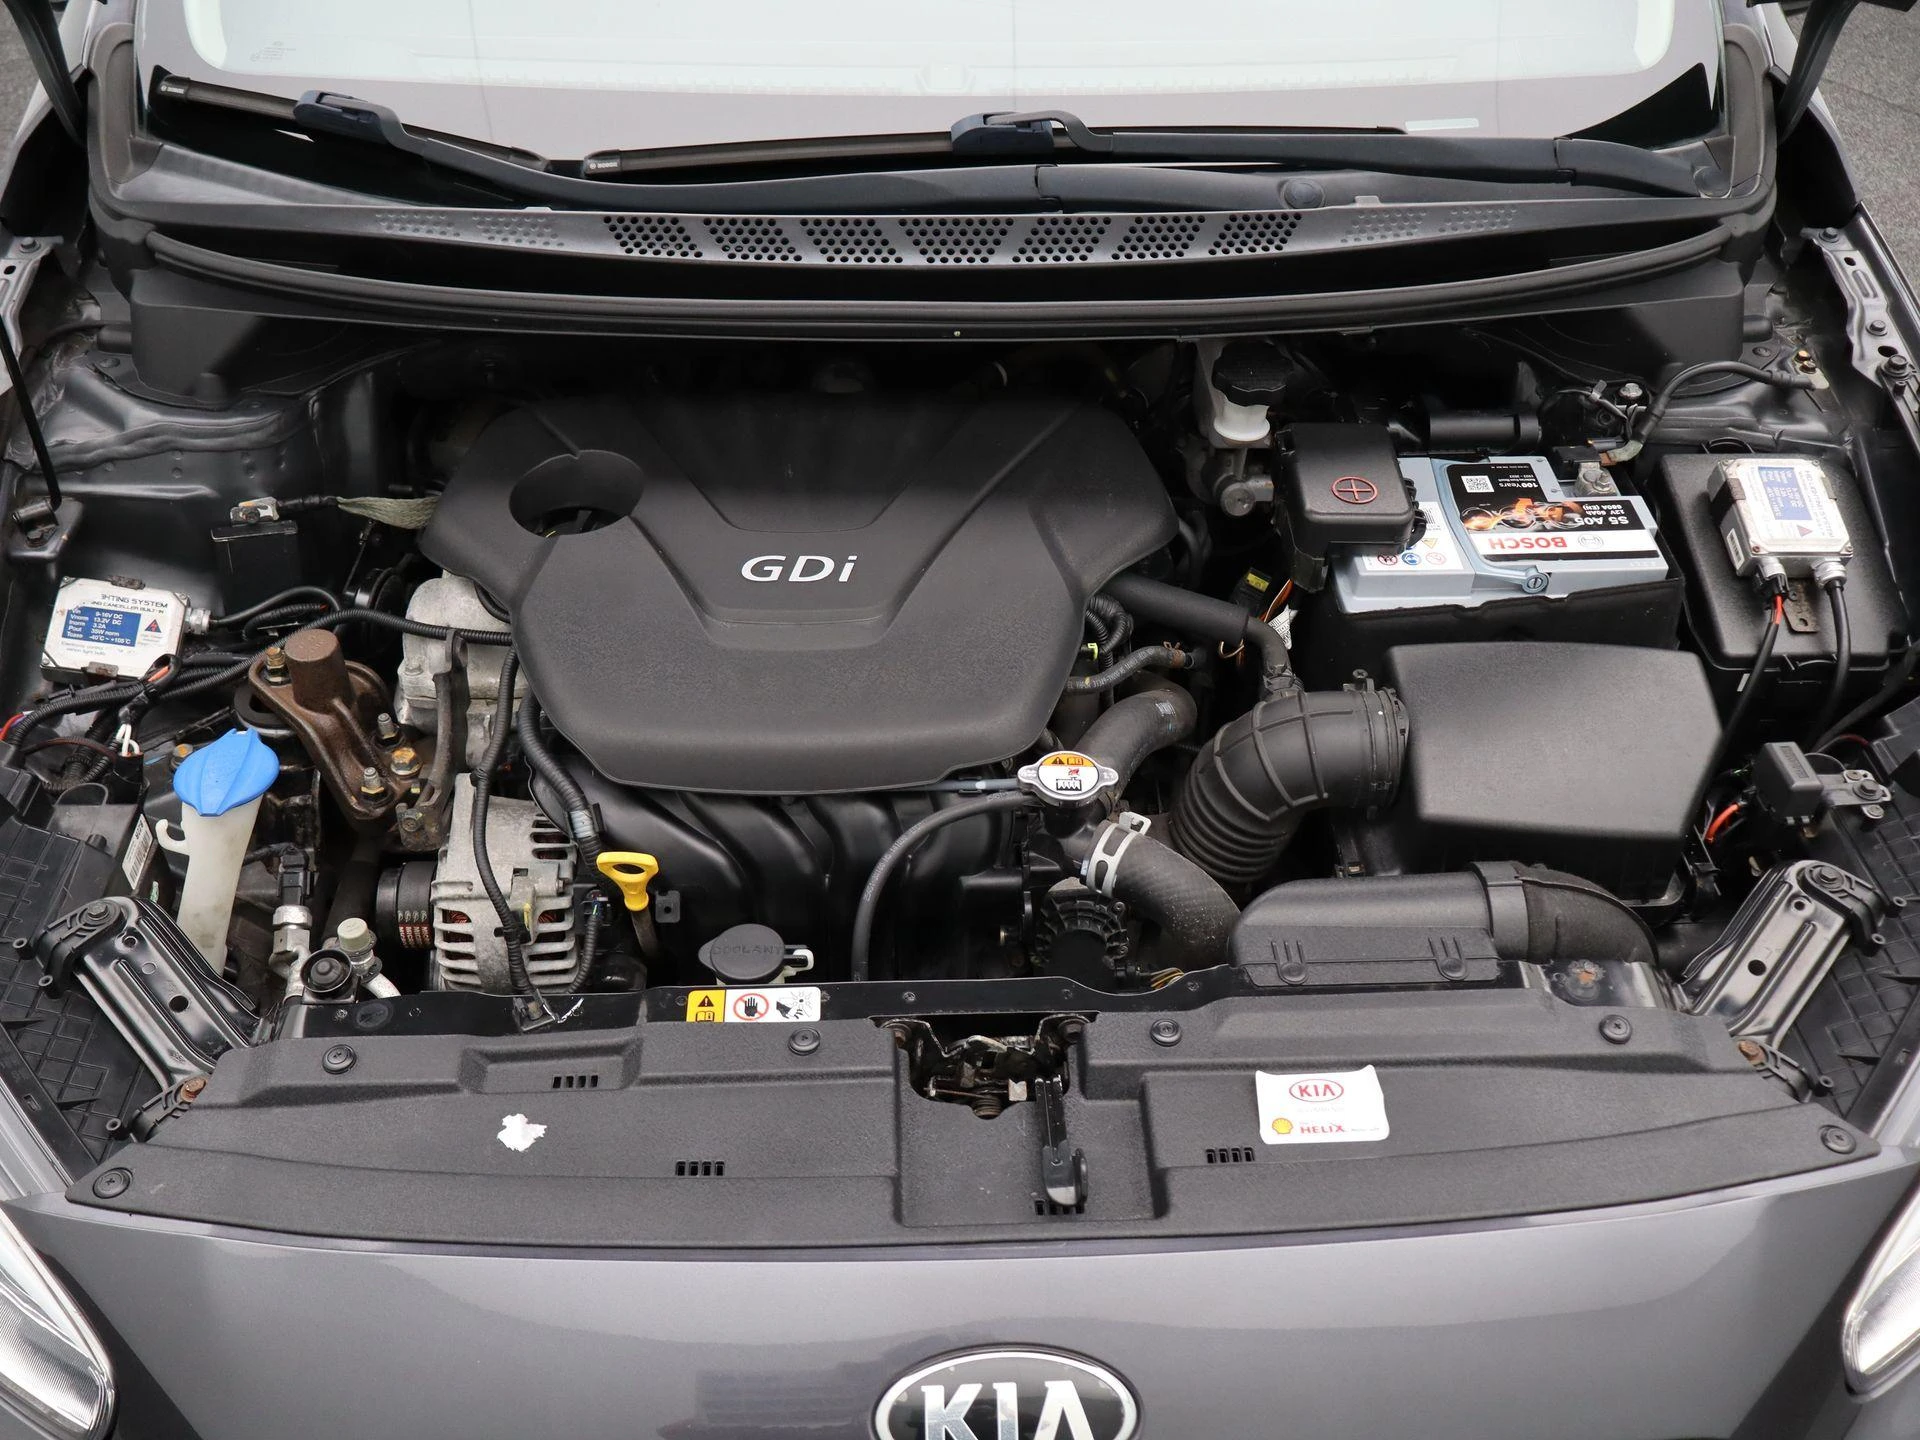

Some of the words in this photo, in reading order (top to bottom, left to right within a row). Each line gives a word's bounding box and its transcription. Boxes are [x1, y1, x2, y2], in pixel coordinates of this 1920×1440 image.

[1574, 517, 1603, 526] A05
[1608, 516, 1629, 524] S5
[1488, 537, 1568, 550] BOSCH
[741, 555, 858, 582] GDi
[132, 599, 168, 608] SYSTEM
[712, 945, 781, 955] COOLANT
[1298, 1084, 1336, 1097] KIA
[1300, 1124, 1345, 1133] HELIX
[921, 1380, 1095, 1440] KIA
